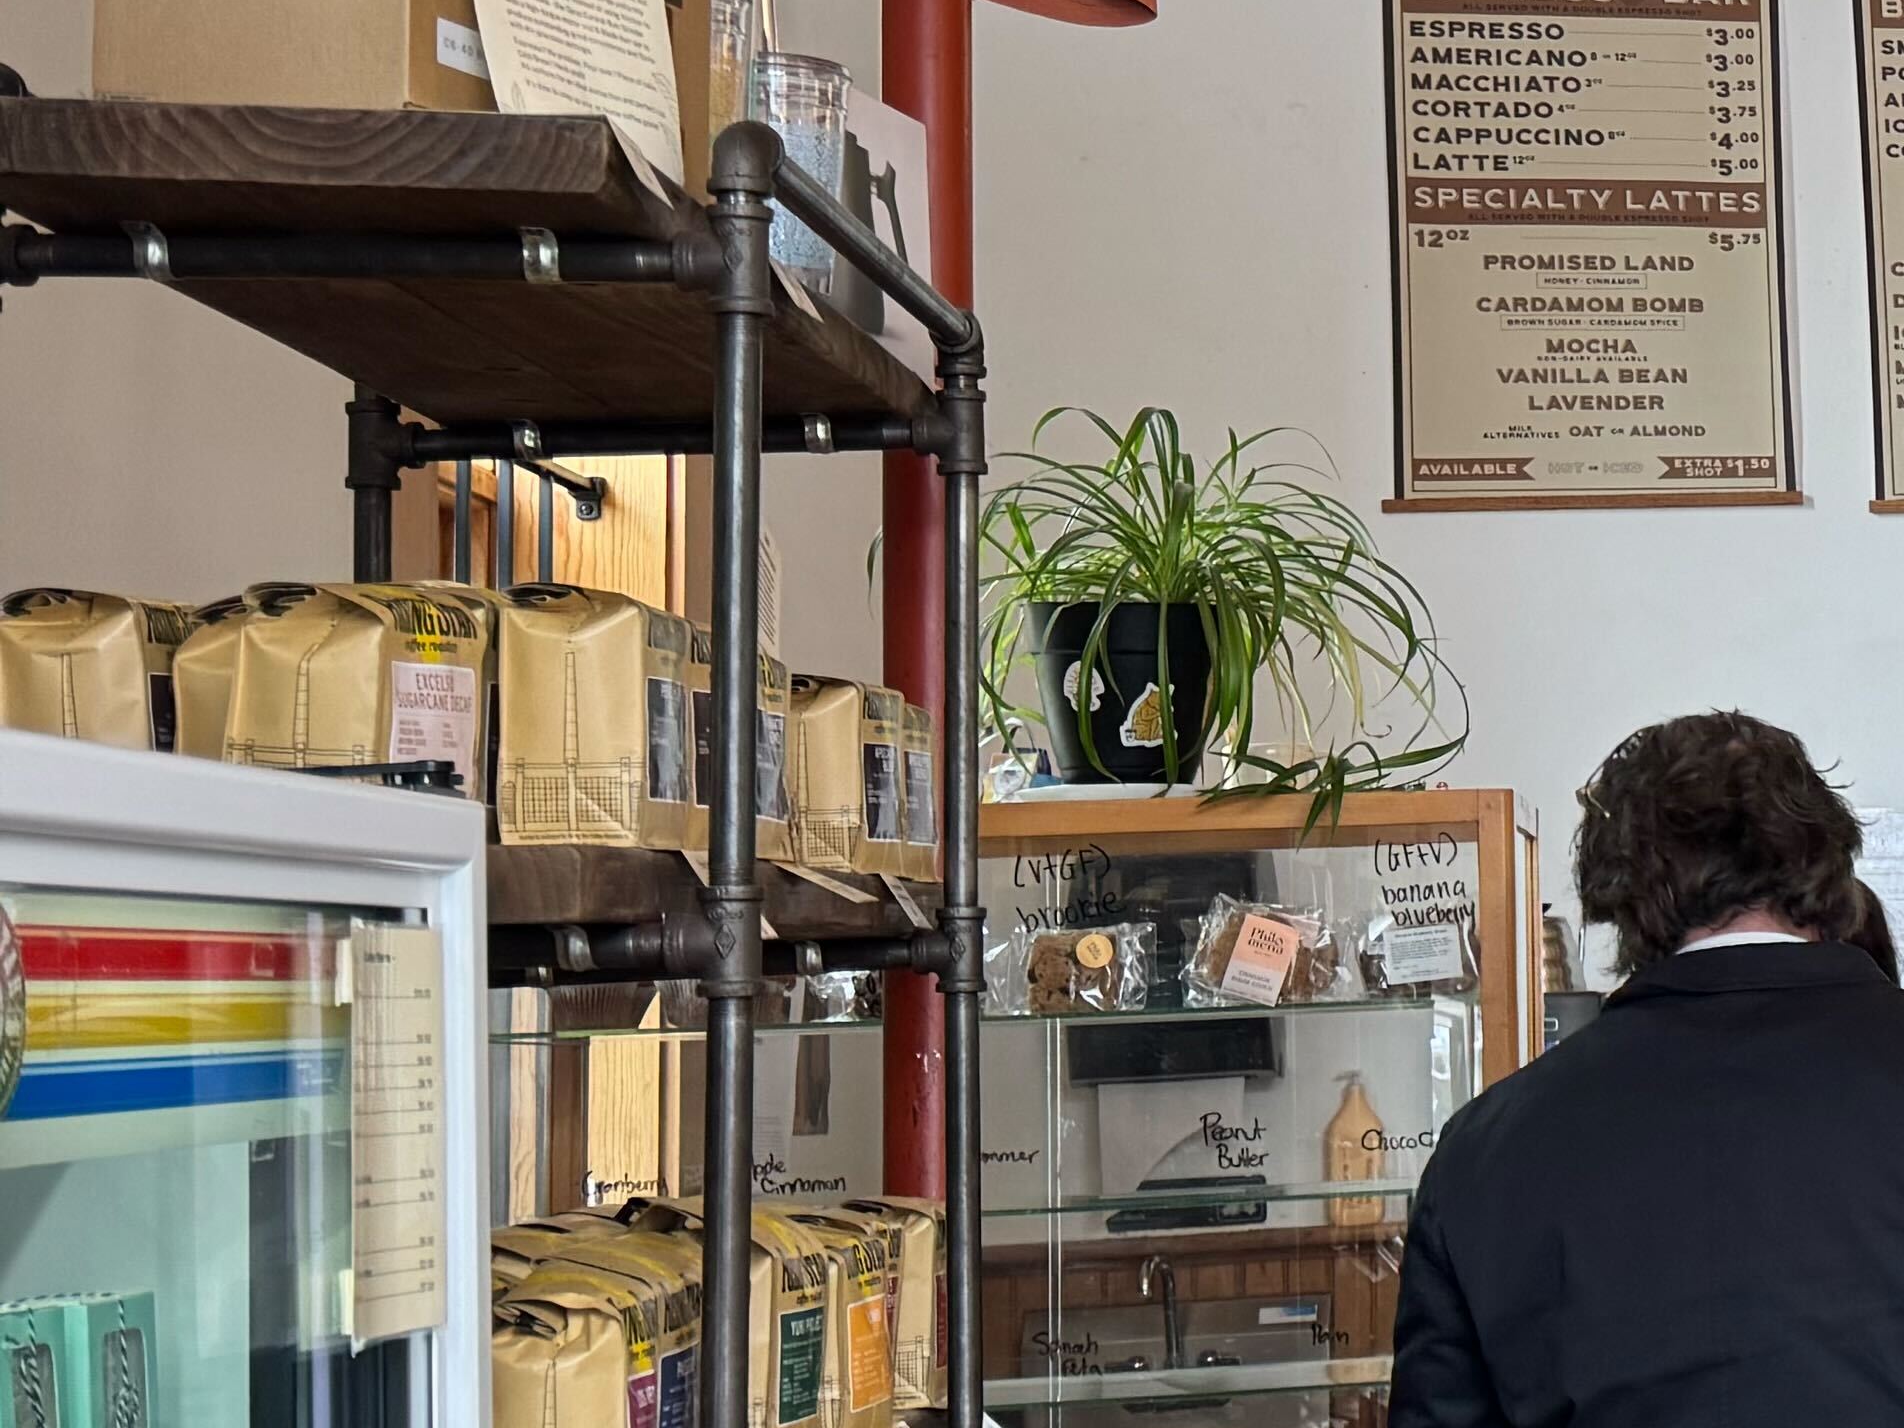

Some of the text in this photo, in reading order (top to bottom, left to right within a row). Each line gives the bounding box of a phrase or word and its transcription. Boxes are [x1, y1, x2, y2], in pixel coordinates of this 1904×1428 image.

[1409, 20, 1755, 46] ESPRESSO $3.00
[1410, 46, 1755, 73] AMERICANO $3.00
[1411, 74, 1756, 98] MACCHIATO $3.25
[1412, 100, 1757, 124] CORTADO $3.75
[1413, 126, 1760, 150] CAPPUCCINO $4.00
[1413, 154, 1759, 176] LATTE $5.00
[1414, 186, 1762, 213] SPECIALTY LATTES
[1413, 229, 1762, 252] 12OZ $5.75
[1483, 254, 1695, 272] PROMISED LAND
[1544, 277, 1640, 285] HONEY CINNAMON
[1476, 297, 1705, 314] CARDAMOM BOMB
[1507, 318, 1678, 327] BROWN SUGAR CARDAMOM SPICE
[1546, 339, 1638, 354] MOCHA
[1496, 368, 1688, 384] VANILLA BEAN
[1528, 395, 1665, 411] LAVENDER
[1483, 425, 1706, 440] ALTERNATIVES OAT ALMOND
[1419, 464, 1517, 475] AVAILABLE
[1548, 462, 1586, 475] HOT
[1674, 459, 1722, 468] EXTRA
[1727, 458, 1770, 477] $1.50
[1686, 467, 1722, 477] SHOT
[1380, 877, 1467, 905] banana
[1016, 888, 1125, 934] brookie
[1391, 902, 1476, 936] blueberry
[1248, 938, 1283, 954] mena
[1251, 927, 1283, 945] Philo
[1199, 1111, 1267, 1147] Peanut
[751, 1153, 787, 1180] pple
[1216, 1144, 1270, 1169] Butter
[582, 1170, 668, 1197] Cranberry
